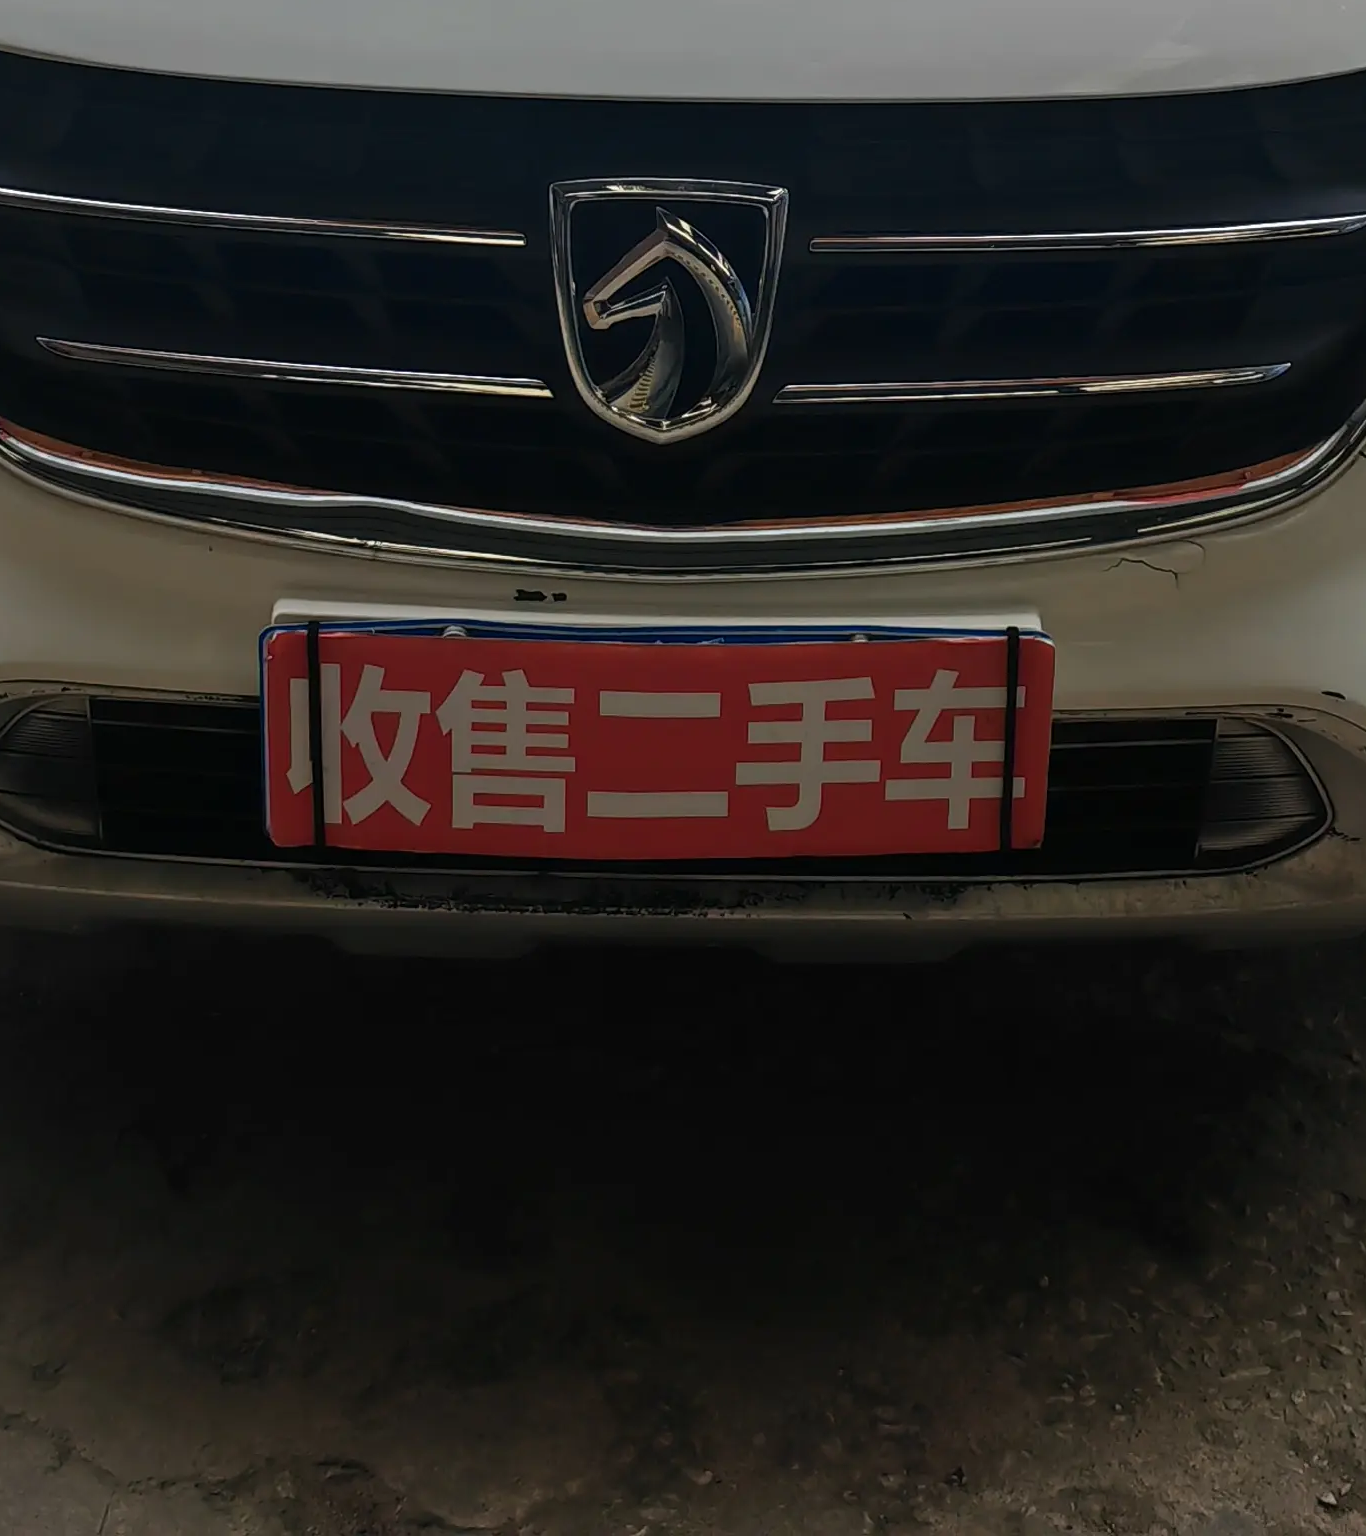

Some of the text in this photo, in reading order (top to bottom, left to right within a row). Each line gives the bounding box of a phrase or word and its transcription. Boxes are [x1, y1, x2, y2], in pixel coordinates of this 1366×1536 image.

[286, 663, 1026, 834] 收售二手车
